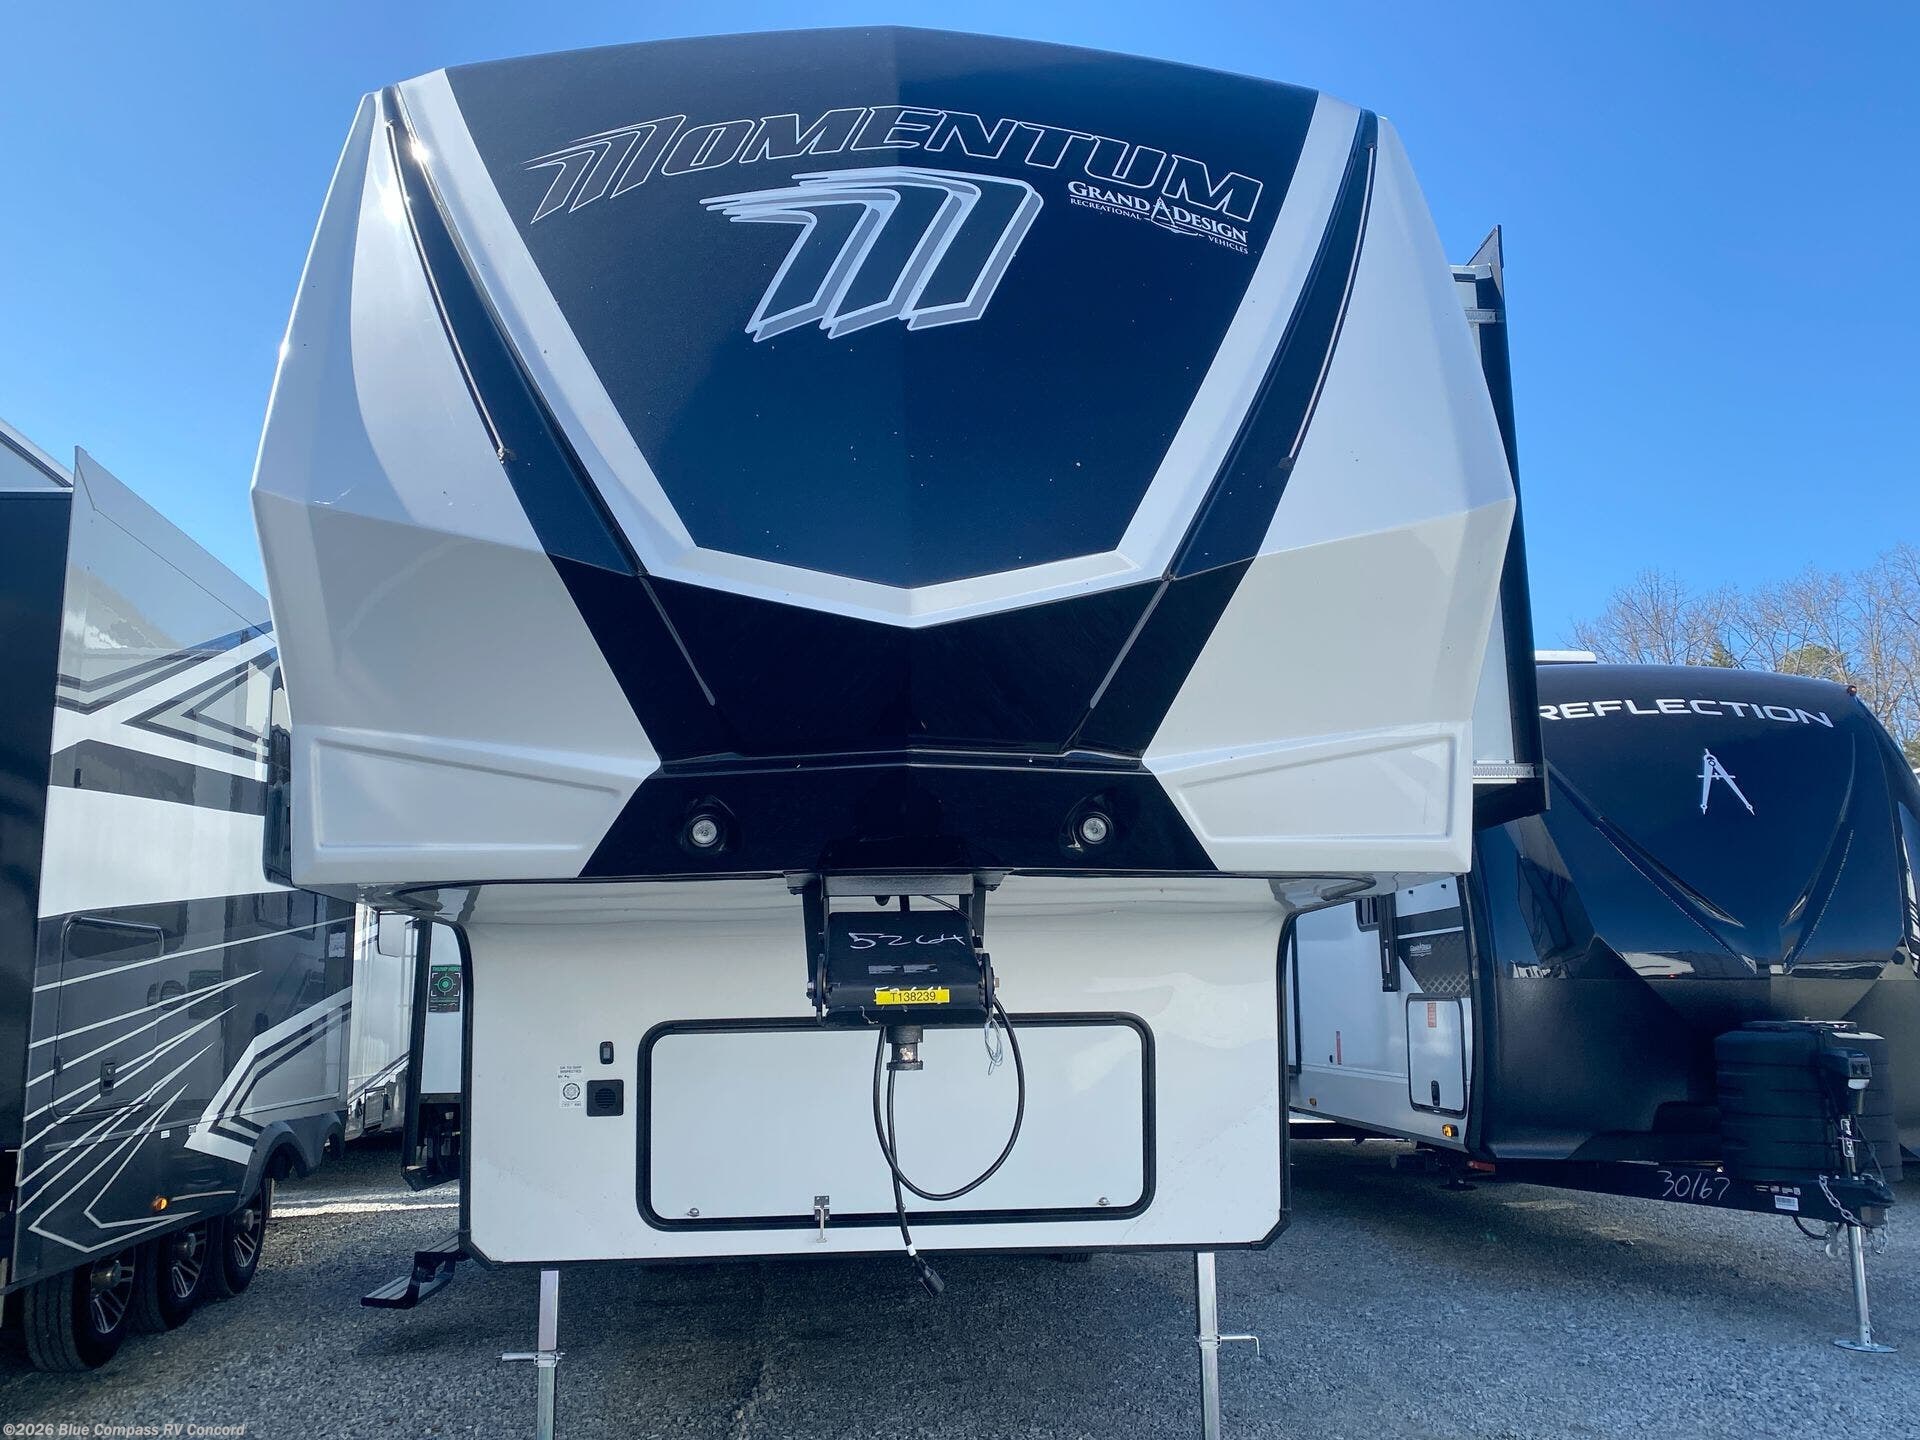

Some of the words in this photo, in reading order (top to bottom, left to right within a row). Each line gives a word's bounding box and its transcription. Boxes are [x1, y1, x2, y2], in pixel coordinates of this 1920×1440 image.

[523, 105, 1264, 224] MOMENTUM
[1067, 181, 1151, 211] GRAND
[1170, 205, 1248, 243] DESIGN
[1070, 198, 1142, 220] RECREATIONAL
[1208, 235, 1249, 254] VEHICLES
[1539, 698, 1834, 728] REFLECTION
[890, 991, 936, 1003] T138239
